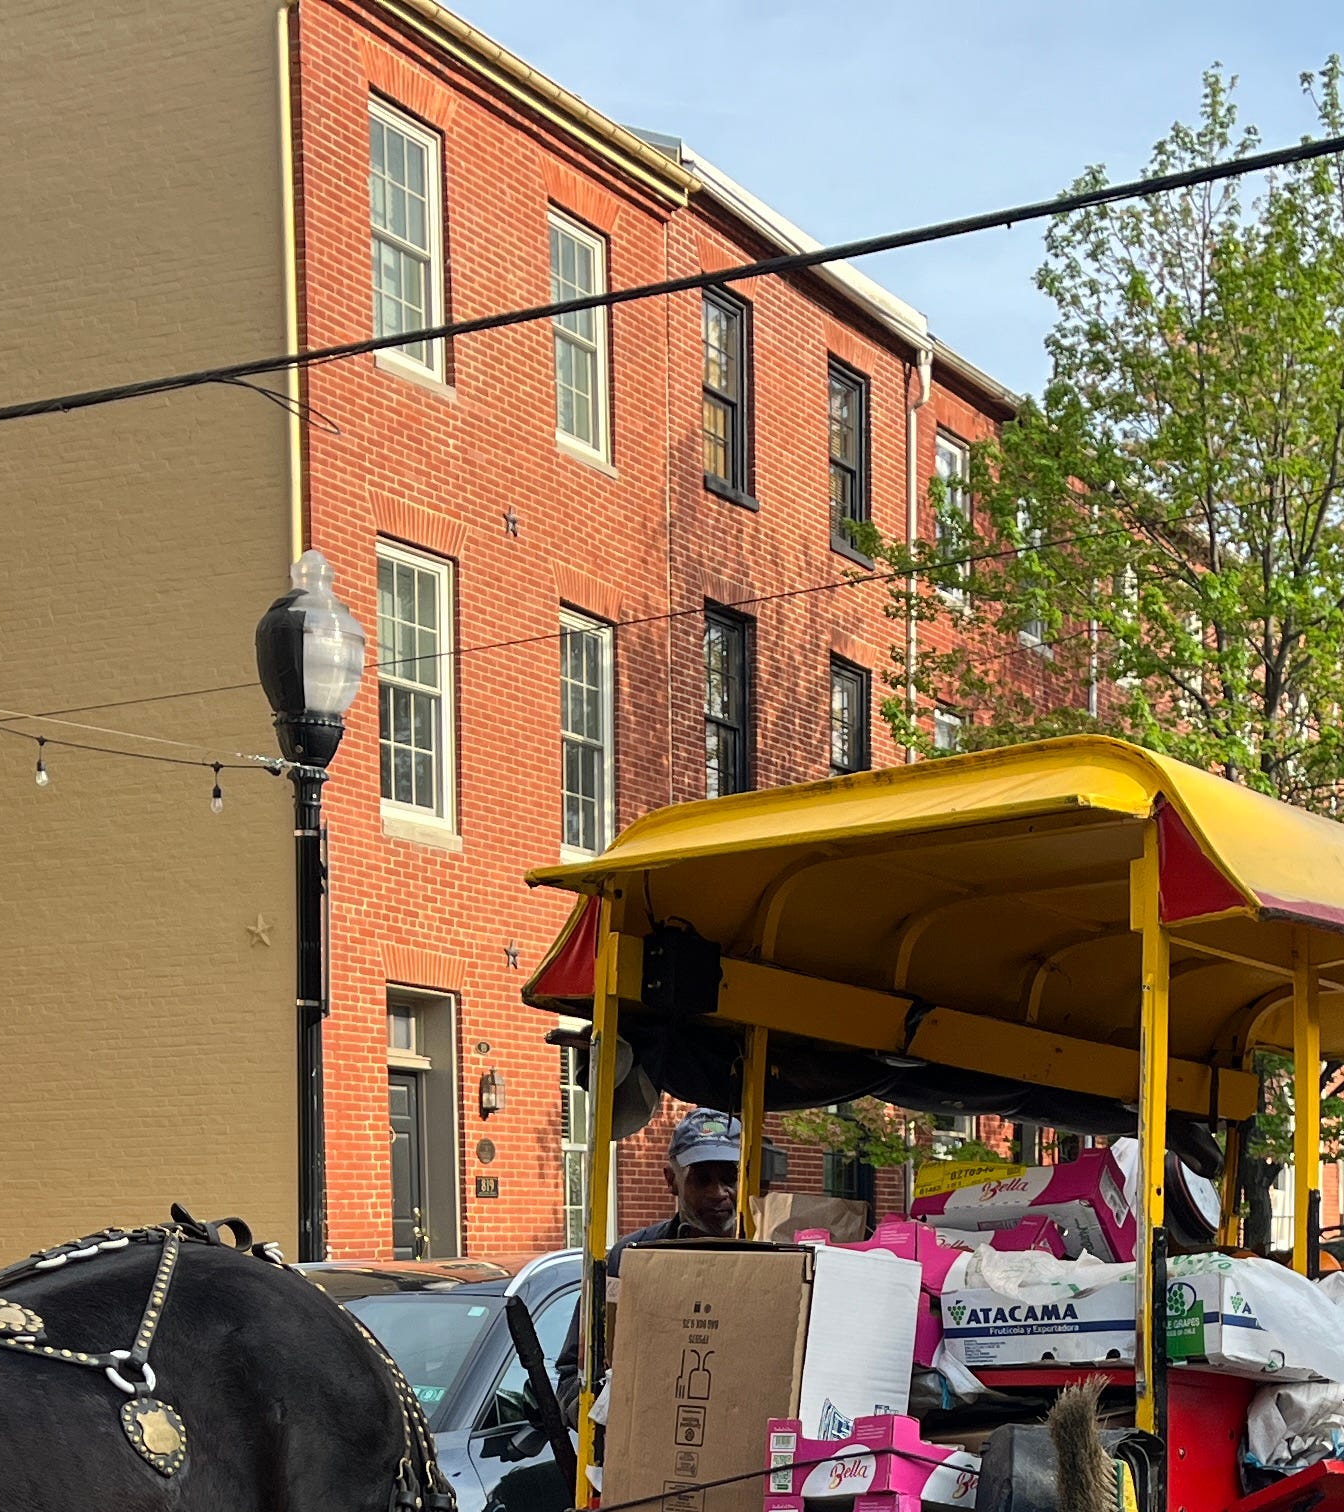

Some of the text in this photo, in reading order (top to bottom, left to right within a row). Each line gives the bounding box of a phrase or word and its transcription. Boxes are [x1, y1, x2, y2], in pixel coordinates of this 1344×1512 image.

[481, 1179, 495, 1192] 819
[979, 1177, 1029, 1202] Bella
[966, 1303, 1079, 1325] ATACAMA
[1032, 1324, 1080, 1334] Exportadora
[828, 1458, 868, 1490] Bella
